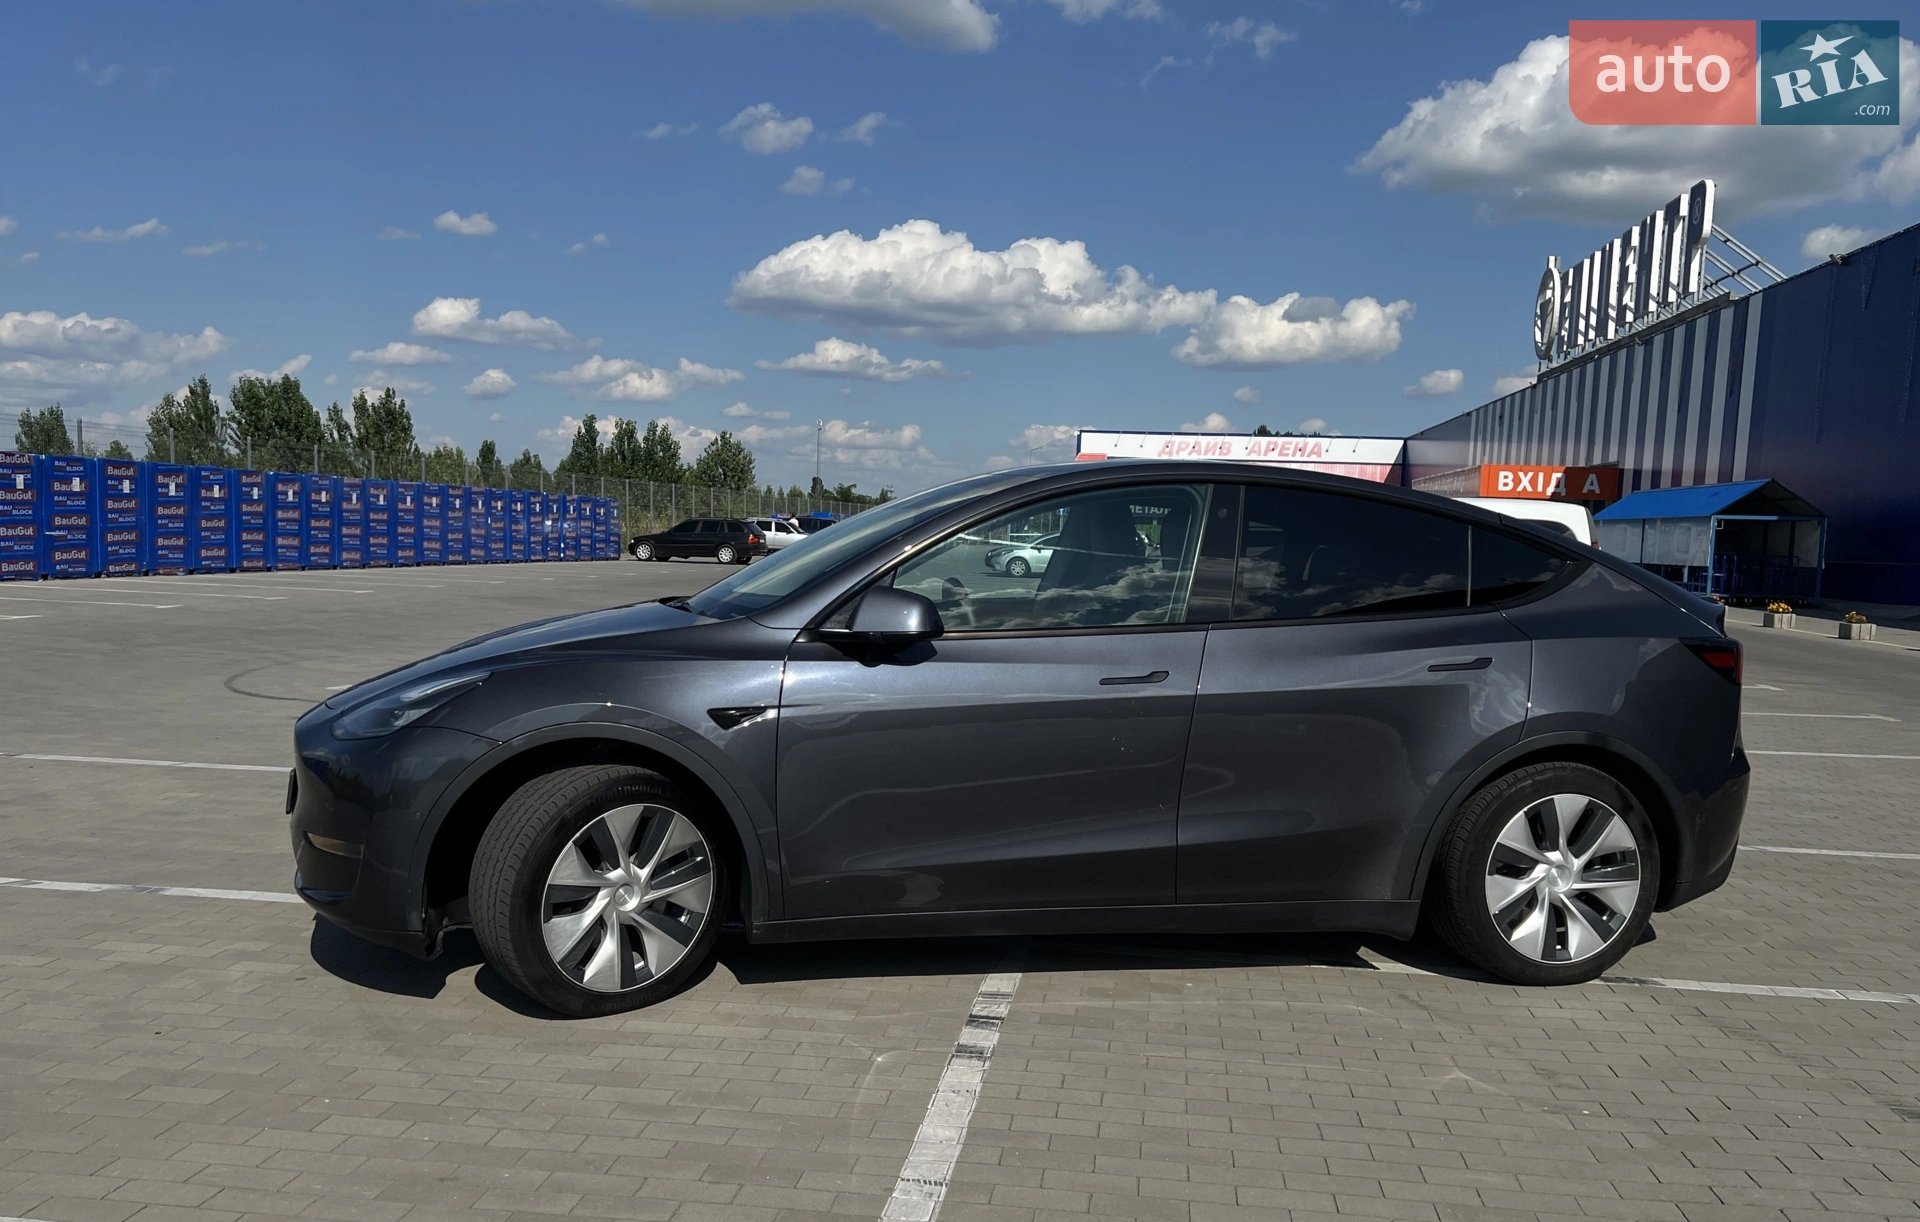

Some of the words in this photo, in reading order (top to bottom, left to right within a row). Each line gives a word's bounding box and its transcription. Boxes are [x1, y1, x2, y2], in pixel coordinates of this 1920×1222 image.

[1246, 440, 1323, 458] АРЕНА
[107, 466, 134, 476] BauGut
[1497, 470, 1567, 497] ВХІД
[1581, 473, 1601, 494] А
[107, 500, 136, 509] BauGut
[54, 516, 86, 525] BauGut
[0, 527, 34, 536] BauGut
[107, 532, 136, 542] BauGut
[55, 550, 86, 560] BauGut
[2, 562, 34, 571] BauGut
